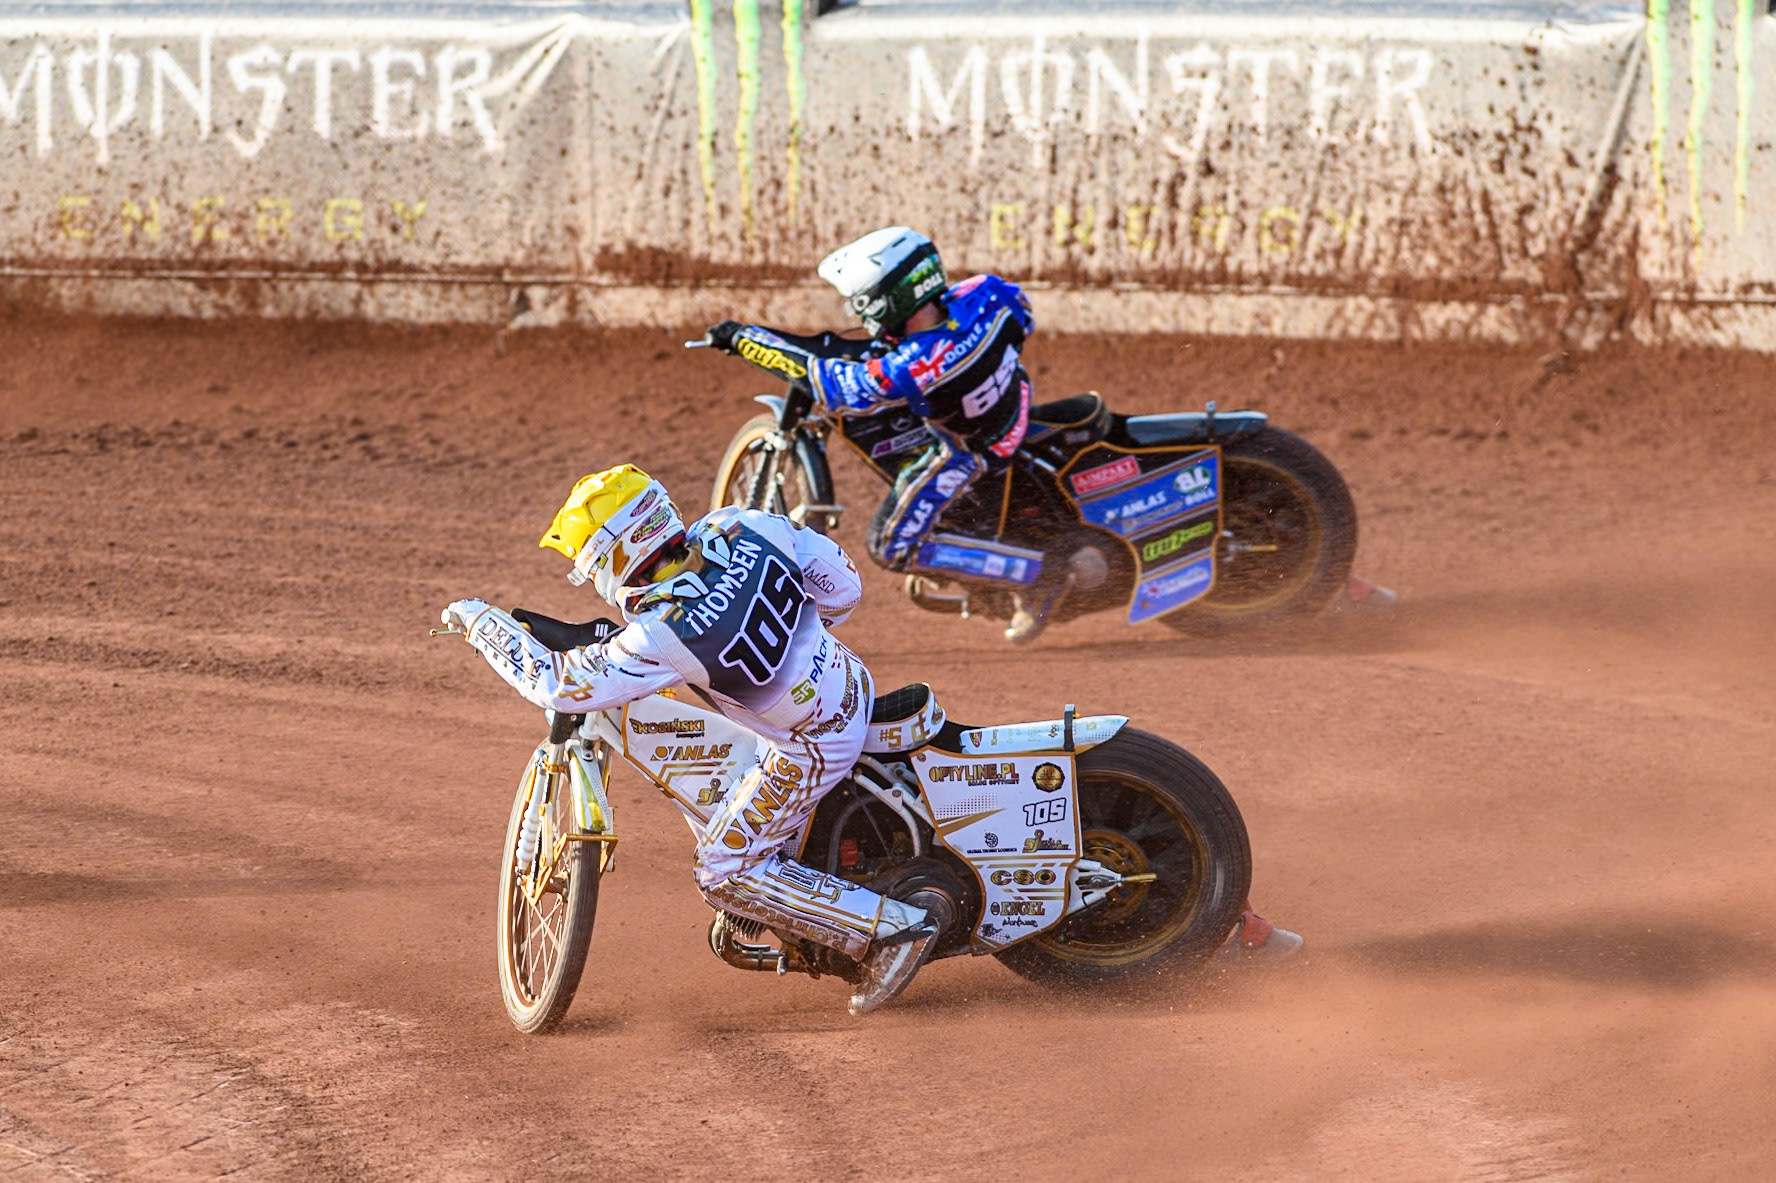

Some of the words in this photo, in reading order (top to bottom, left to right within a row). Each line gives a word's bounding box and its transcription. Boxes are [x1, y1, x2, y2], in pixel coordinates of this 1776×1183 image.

[0, 30, 504, 165] MONSTER
[907, 28, 1439, 168] MONSTER
[60, 197, 427, 241] ENERGY
[944, 322, 983, 363] DOYLE
[685, 539, 763, 636] THOMSEN
[718, 554, 807, 686] 105
[671, 744, 732, 761] ANLAS
[742, 757, 804, 835] ANLAS
[1022, 797, 1067, 827] 105
[1000, 902, 1046, 916] ENGEL
